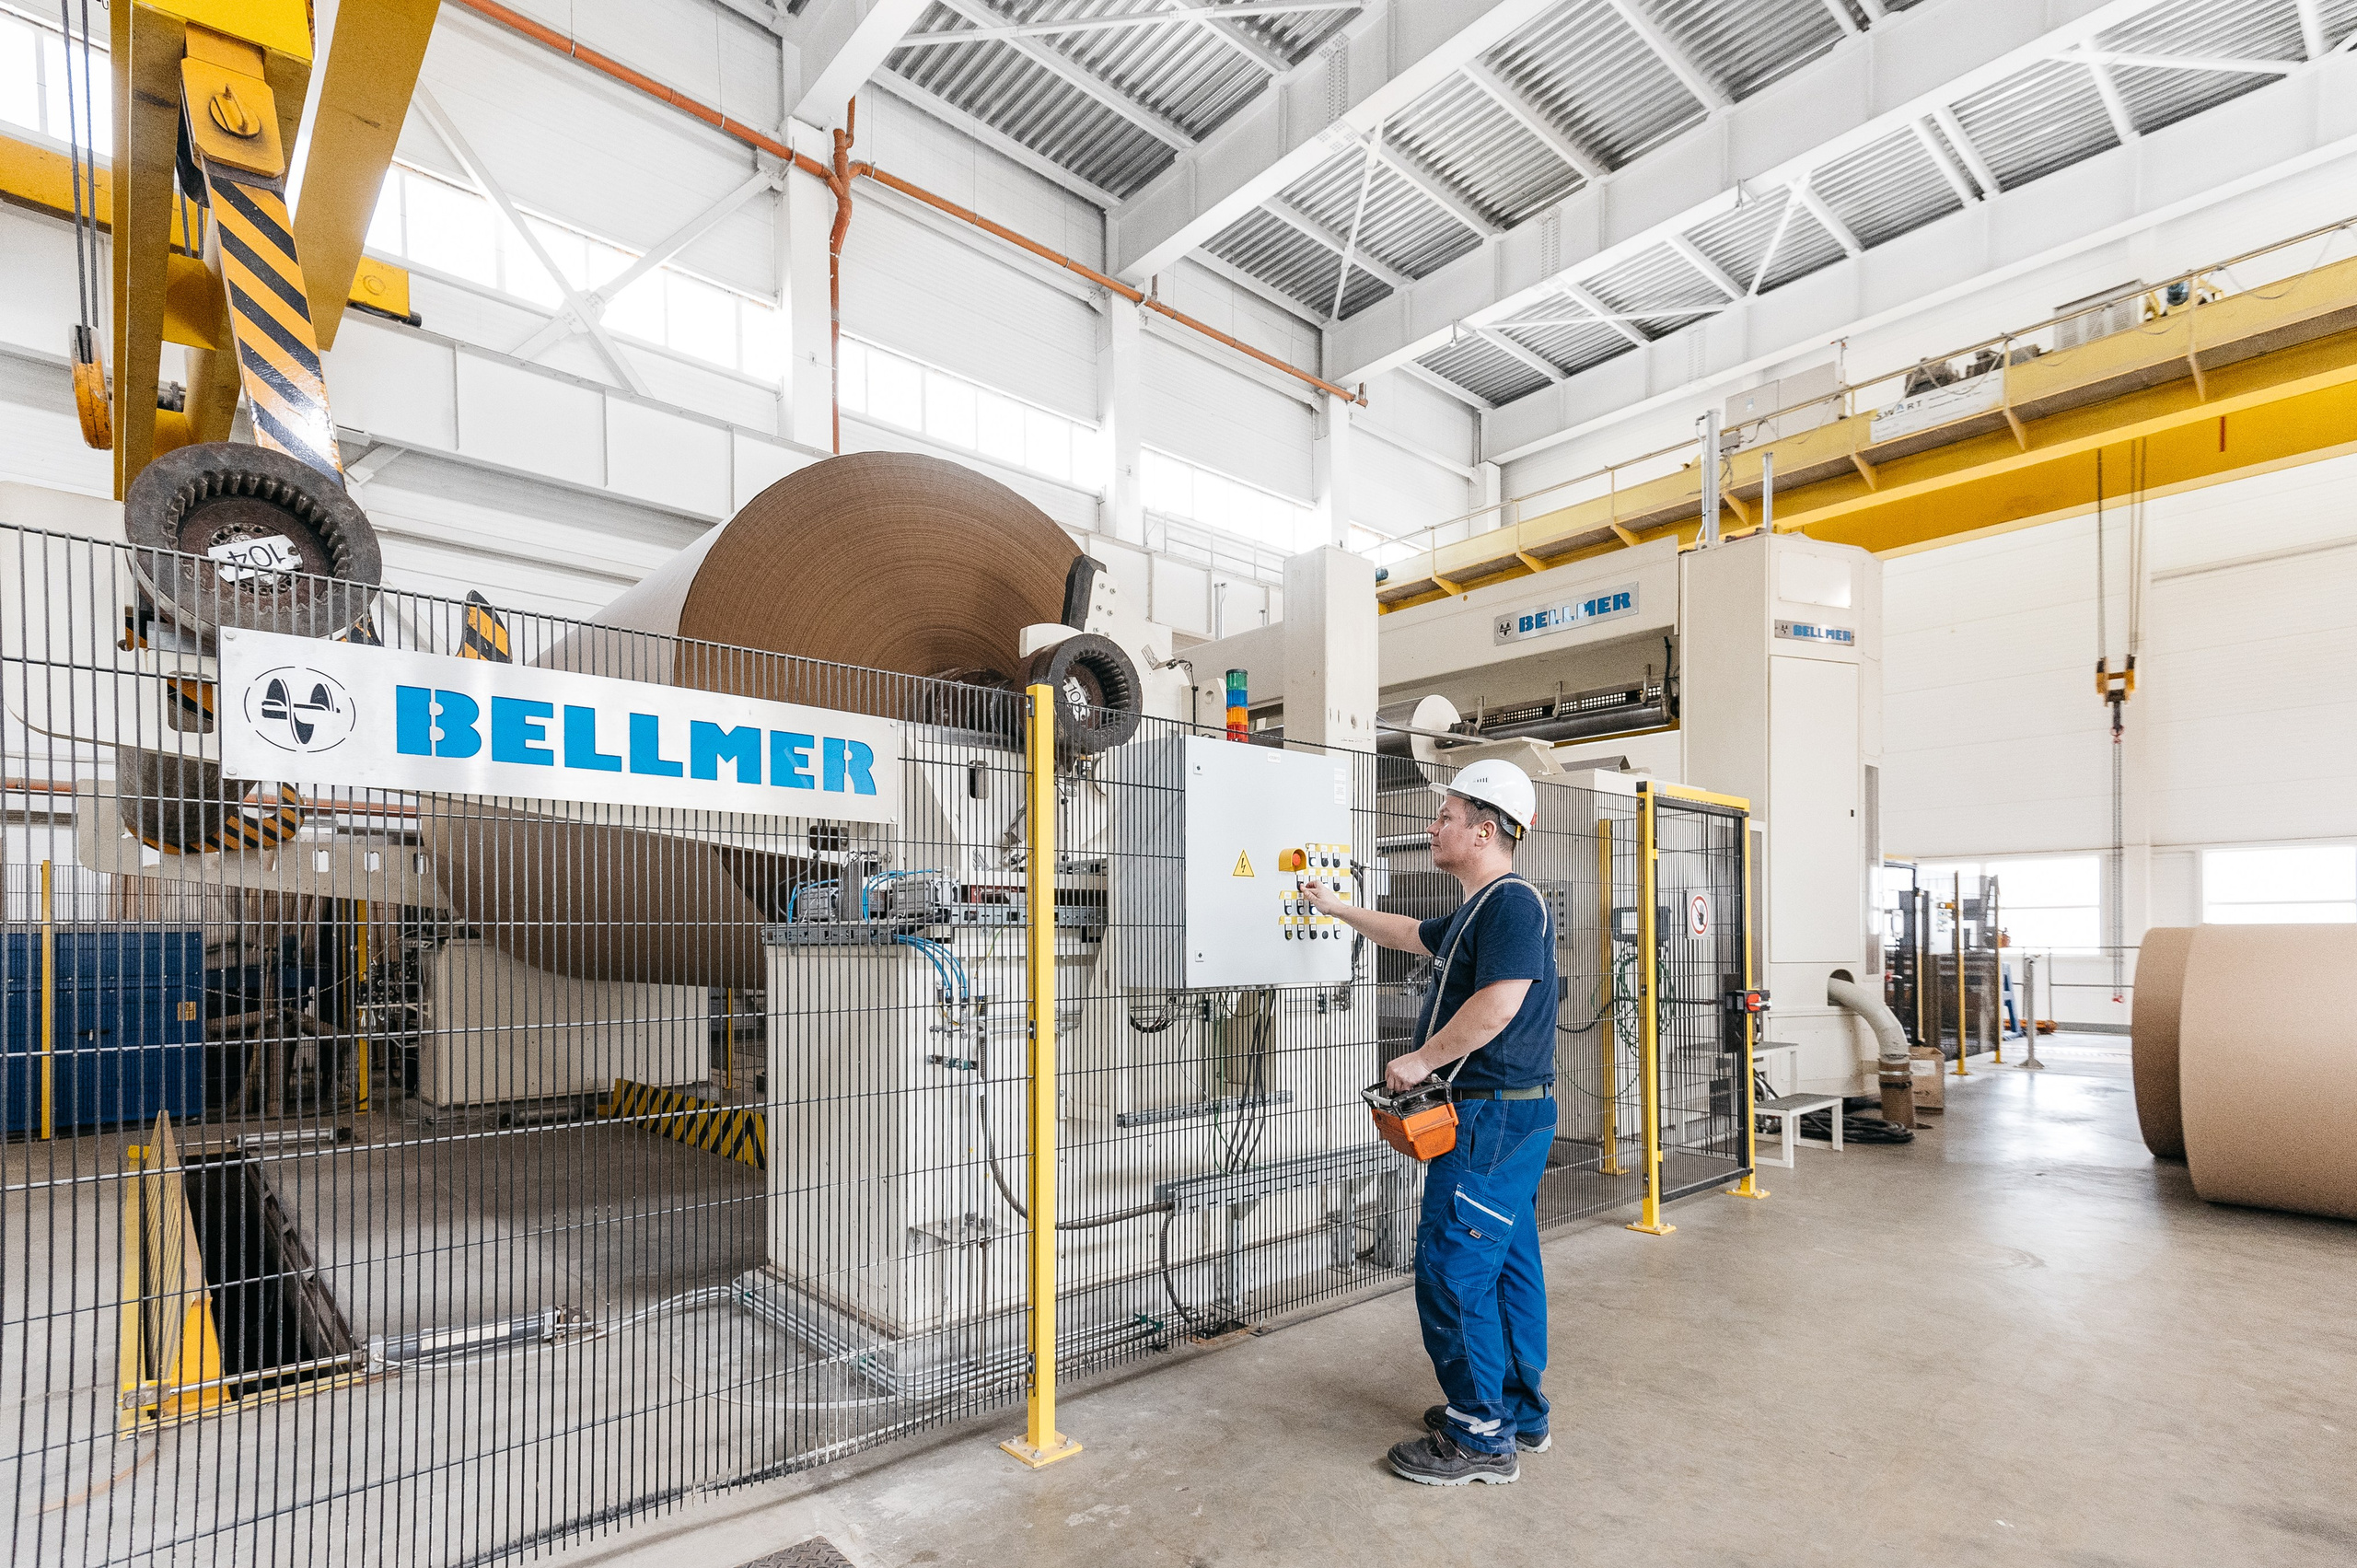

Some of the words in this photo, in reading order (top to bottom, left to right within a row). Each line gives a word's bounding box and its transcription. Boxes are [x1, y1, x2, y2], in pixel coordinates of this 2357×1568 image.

[227, 543, 286, 572] 104
[1519, 592, 1631, 633] BELLMER
[1794, 625, 1851, 642] BELLMER
[396, 685, 877, 796] BELLMER
